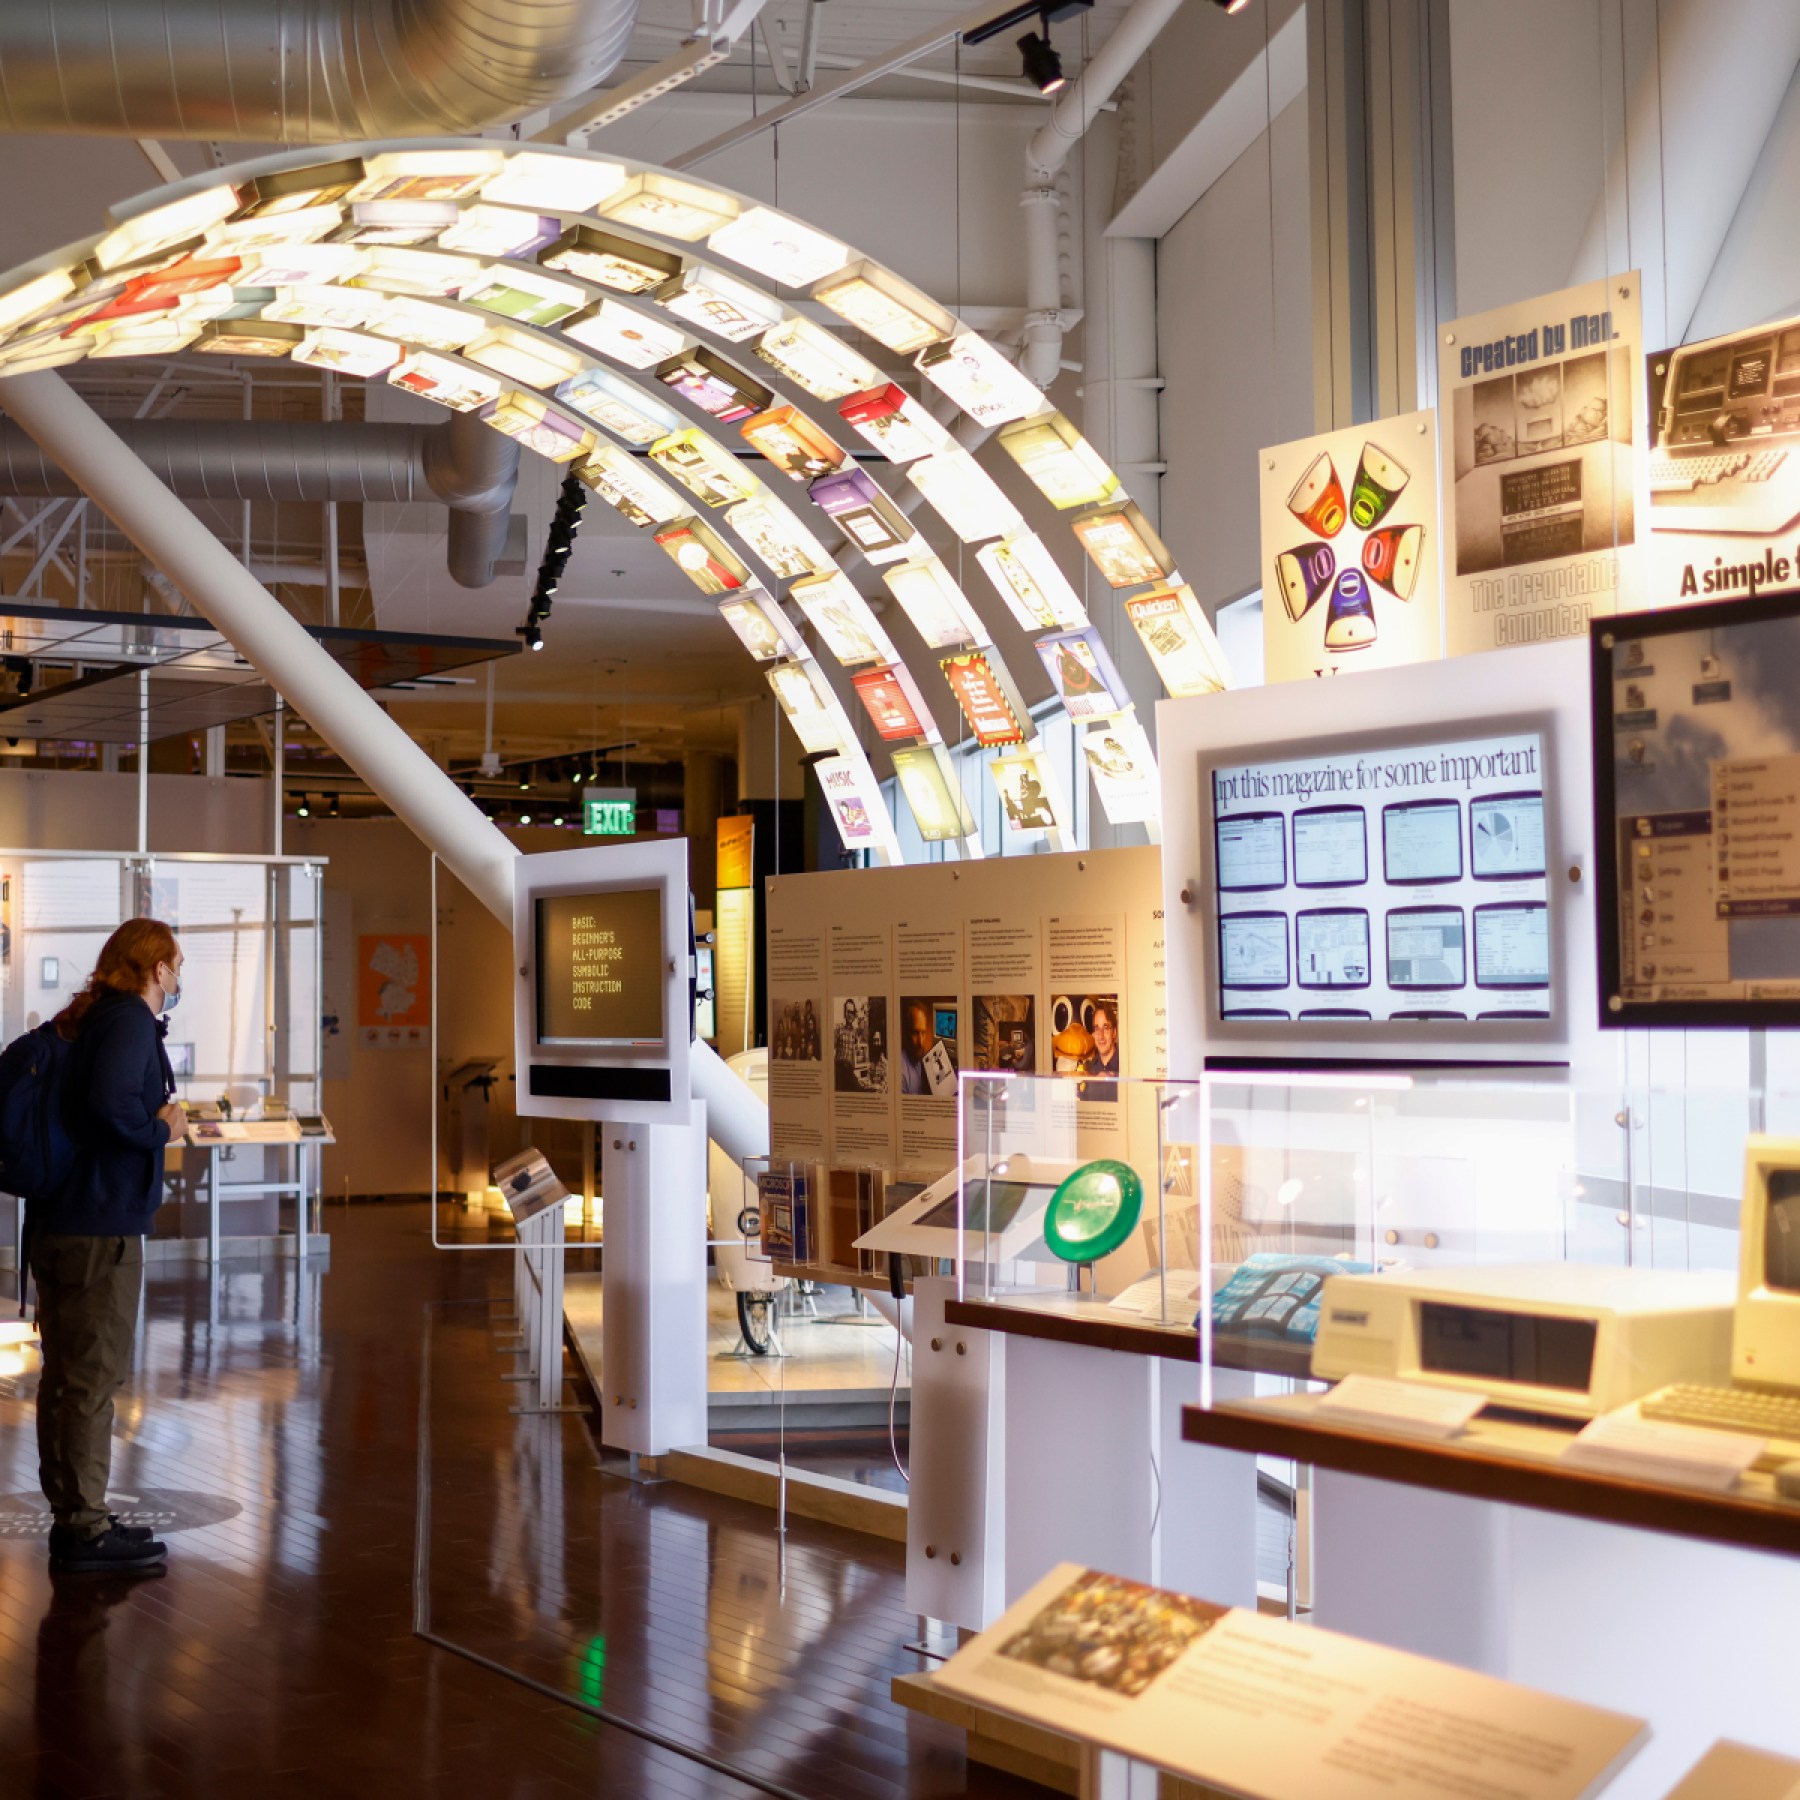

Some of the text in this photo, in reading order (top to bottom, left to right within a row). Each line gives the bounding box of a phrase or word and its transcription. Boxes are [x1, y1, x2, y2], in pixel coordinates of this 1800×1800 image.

[1461, 311, 1620, 378] Created by Man.
[1680, 564, 1698, 598] A
[1703, 547, 1790, 597] simple
[1470, 558, 1618, 612] The Affordable
[1241, 769, 1269, 799] this
[1273, 765, 1353, 802] magazine
[1357, 759, 1383, 790] for
[1385, 760, 1436, 788] some
[1440, 744, 1537, 789] important
[591, 803, 631, 832] EXIT
[572, 916, 597, 929] BASIC:
[572, 947, 624, 961] ALL-PURPOSE
[572, 964, 610, 978] SYMBOLIC
[572, 980, 623, 994] INSTRUCTION
[572, 997, 592, 1010] CODE
